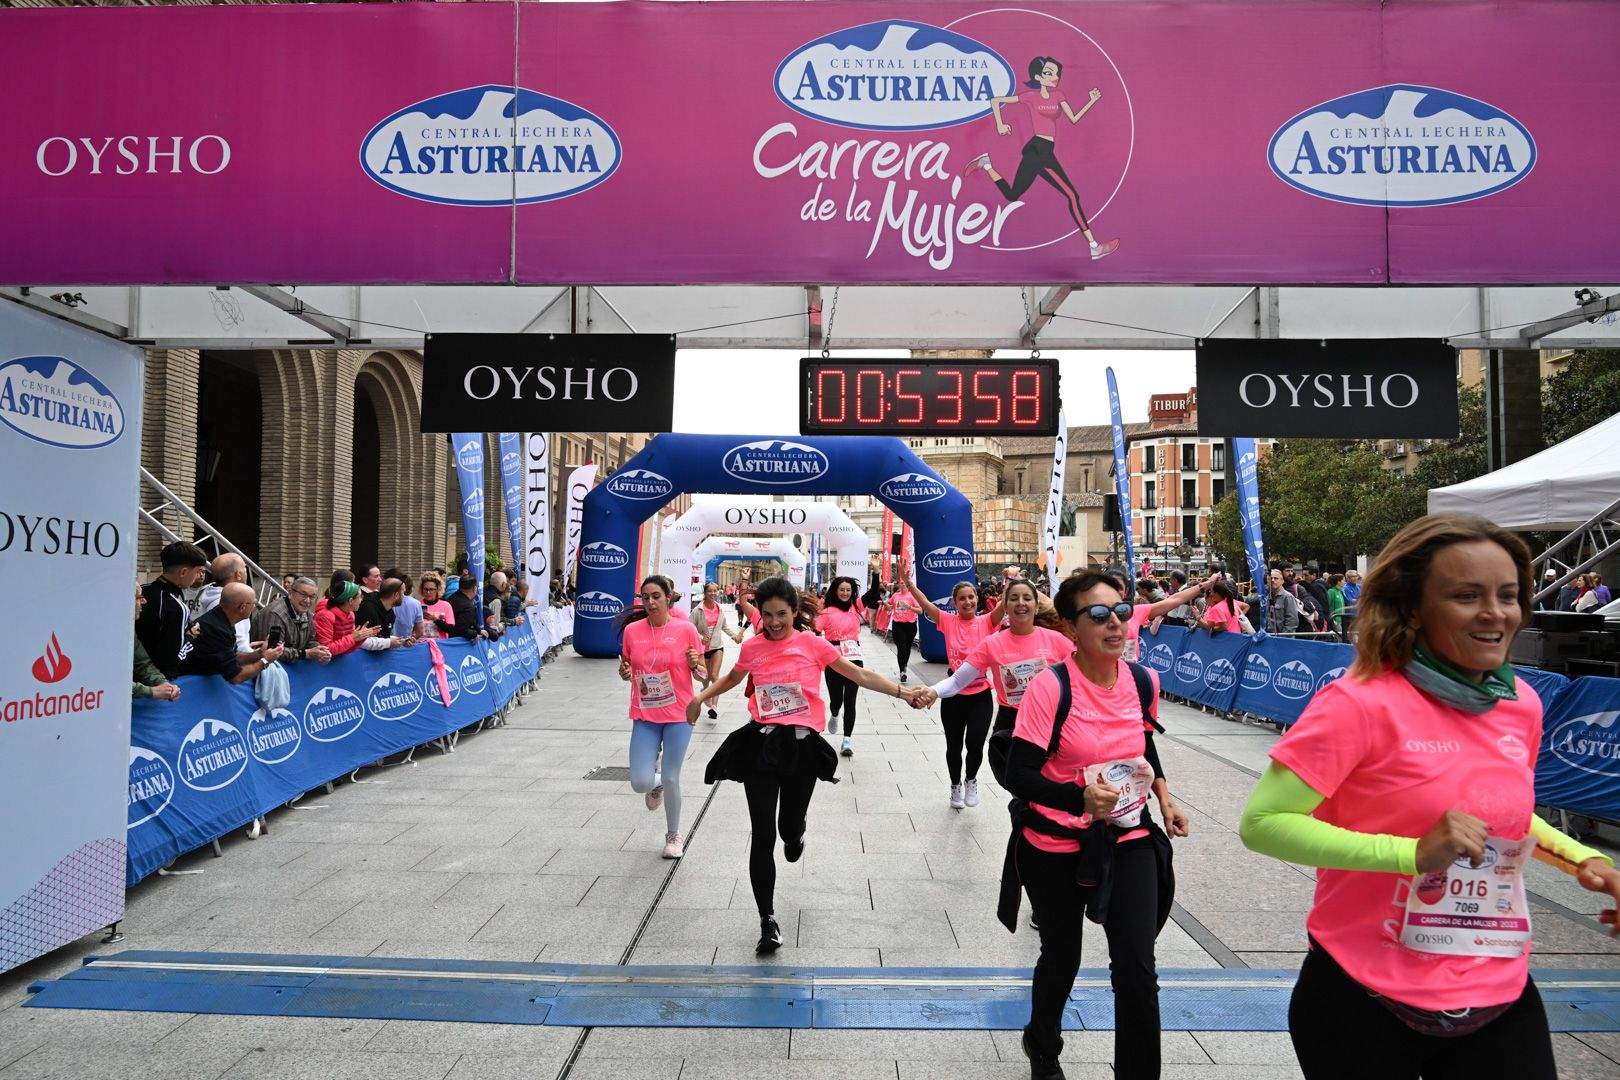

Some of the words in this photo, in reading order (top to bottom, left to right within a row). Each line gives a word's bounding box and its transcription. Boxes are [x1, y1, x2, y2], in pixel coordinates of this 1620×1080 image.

[830, 58, 905, 70] CENTRAL
[913, 58, 989, 70] LECHERA
[793, 60, 996, 102] ASTURIANA
[421, 128, 501, 139] CENTRAL
[510, 126, 592, 138] LECHERA
[1330, 127, 1413, 139] CENTRAL
[1422, 126, 1506, 138] LECHERA
[36, 135, 231, 176] OYSHO
[380, 130, 602, 175] ASTURIANA
[753, 122, 951, 181] Carrera
[1288, 130, 1517, 175] ASTURIANA
[800, 182, 837, 222] de
[845, 181, 872, 223] la
[865, 175, 1026, 271] Mujer
[21, 378, 67, 400] CENTRAL
[71, 392, 113, 410] LECHERA
[464, 365, 638, 402] OYSHO
[1239, 373, 1419, 409] OYSHO
[0, 375, 116, 435] ASTURIANA
[1153, 399, 1186, 411] TIBUR
[730, 452, 821, 474] ASTURIANA
[1158, 449, 1166, 492] HOTEL
[609, 479, 668, 494] ASTURIANA
[885, 484, 942, 497] ASTURIANA
[528, 433, 547, 577] OYSHO
[725, 508, 807, 525] OYSHO
[1158, 496, 1166, 537] TIBUR
[581, 550, 625, 564] ASTURIANA
[663, 558, 687, 566] OYSHO
[577, 600, 621, 614] ASTURIANA
[0, 687, 104, 723] antander
[373, 690, 421, 714] ASTURIANA
[773, 696, 791, 707] 016
[309, 705, 362, 735] ASTURIANA
[251, 725, 299, 754] ASTURIANA
[1405, 738, 1461, 753] OYSHO
[185, 743, 247, 782] ASTURIANA
[1450, 878, 1488, 898] 016
[1455, 901, 1480, 913] 7069
[1420, 916, 1451, 925] CARRERA
[1451, 917, 1462, 926] DE
[1462, 918, 1473, 926] LA
[1473, 918, 1498, 928] MUJER
[1415, 933, 1454, 945] OYSHO
